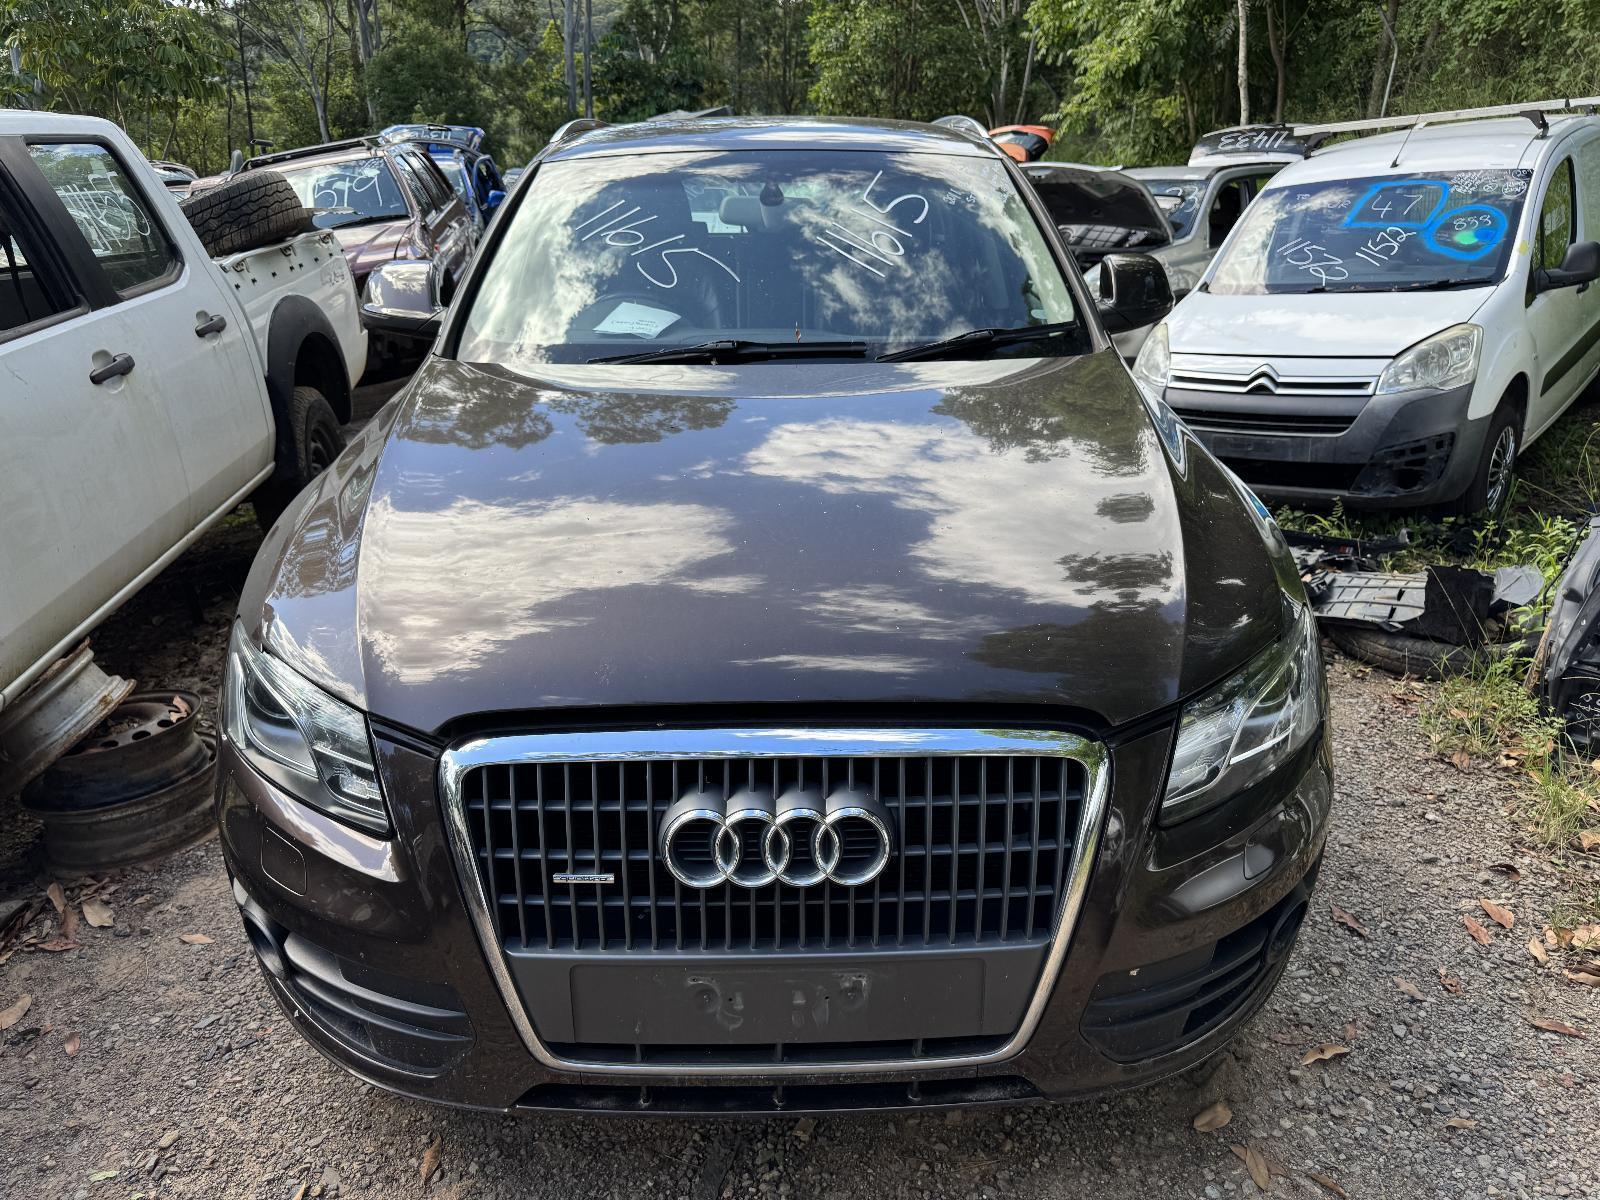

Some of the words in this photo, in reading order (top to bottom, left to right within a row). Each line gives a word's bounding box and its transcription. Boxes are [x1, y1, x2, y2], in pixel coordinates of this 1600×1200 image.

[816, 170, 929, 278] 11615
[1371, 194, 1424, 219] 47
[575, 199, 741, 289] 11615
[1355, 226, 1417, 267] 11572
